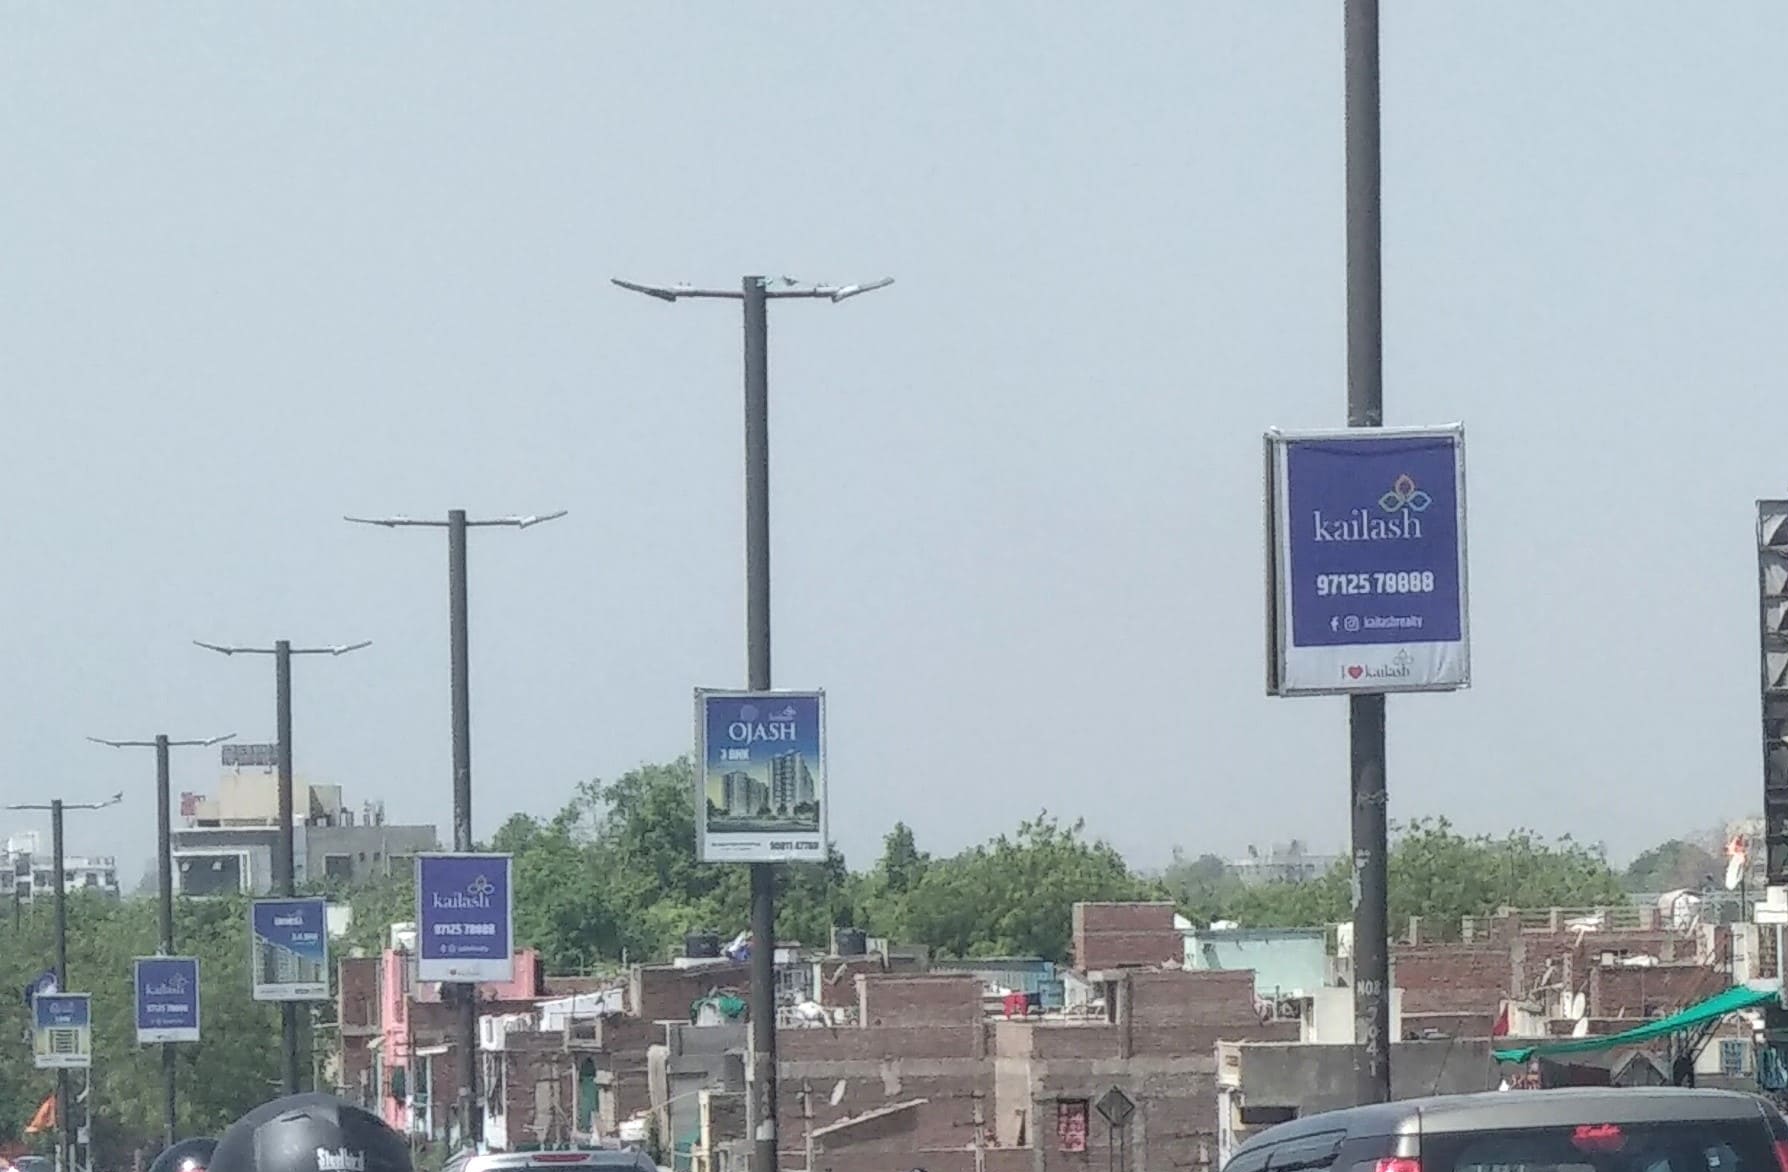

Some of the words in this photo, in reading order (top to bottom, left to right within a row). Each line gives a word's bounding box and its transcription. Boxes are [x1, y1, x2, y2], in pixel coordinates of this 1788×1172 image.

[1313, 508, 1423, 542] kailash
[1316, 573, 1370, 596] 97125
[1373, 571, 1435, 594] 78888
[728, 721, 797, 744] OJASH
